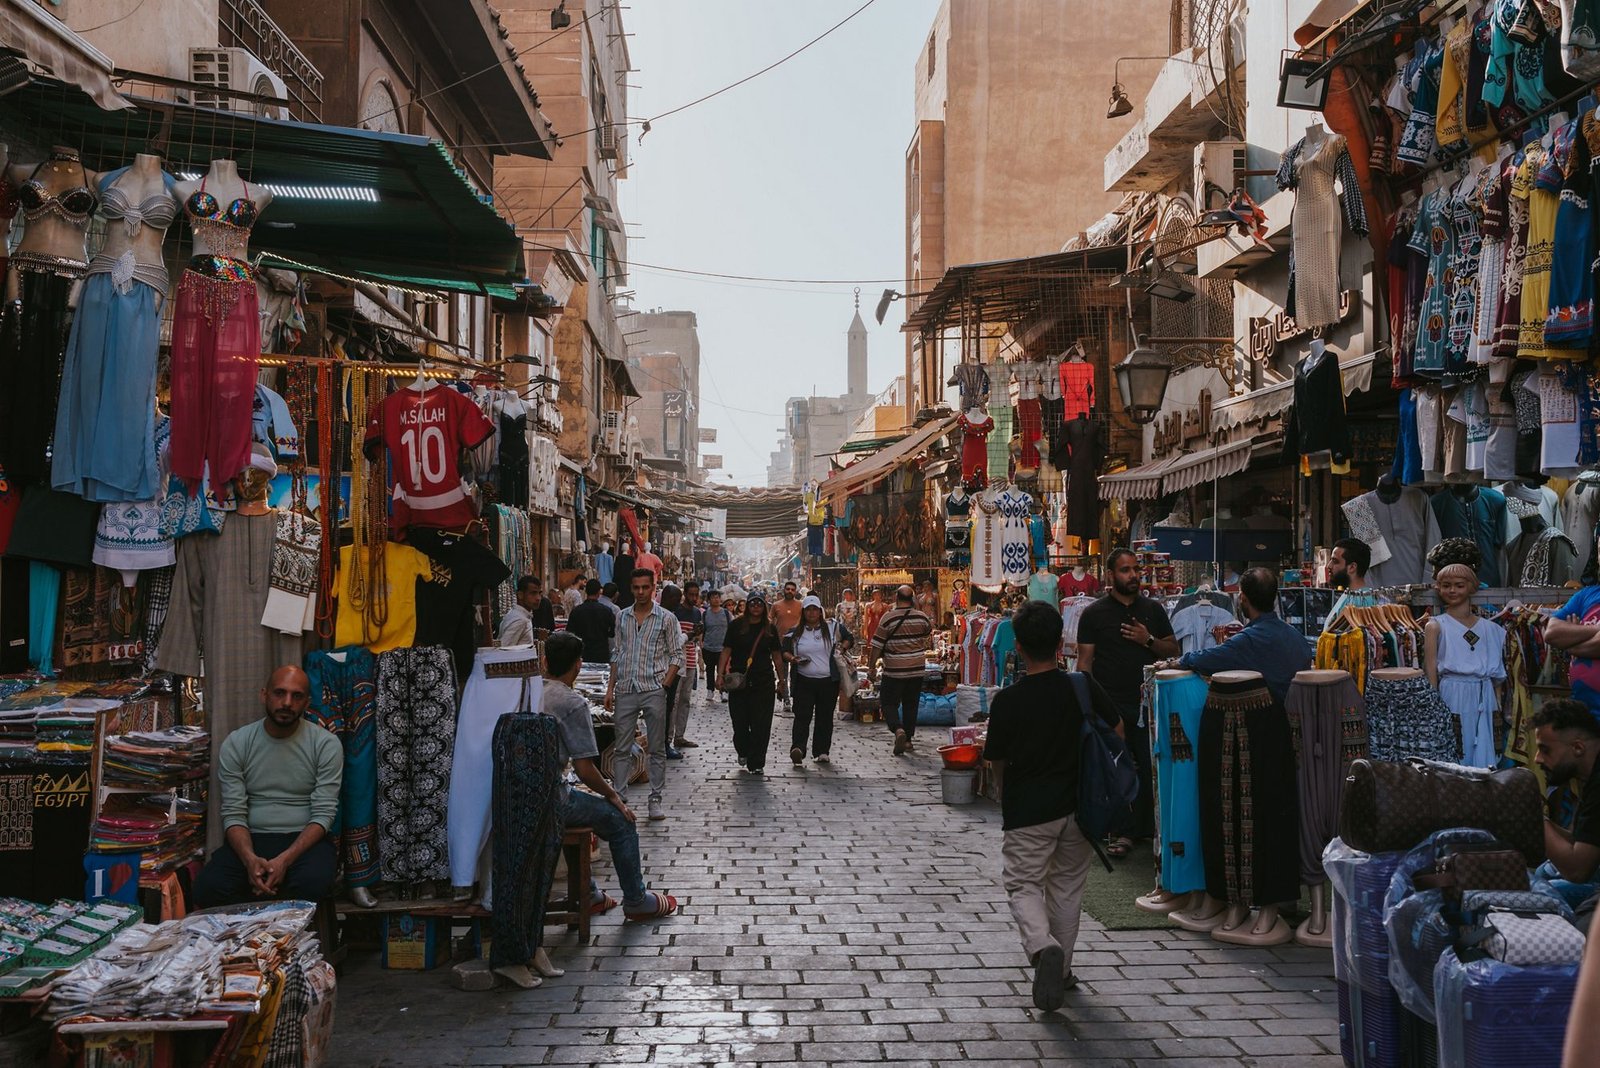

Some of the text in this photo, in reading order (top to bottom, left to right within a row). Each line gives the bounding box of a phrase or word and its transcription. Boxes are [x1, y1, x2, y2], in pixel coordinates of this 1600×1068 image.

[400, 407, 446, 425] M.SALAH
[401, 426, 447, 488] 10
[432, 572, 450, 587] YPT
[34, 793, 89, 808] EGYPT
[92, 868, 106, 898] I
